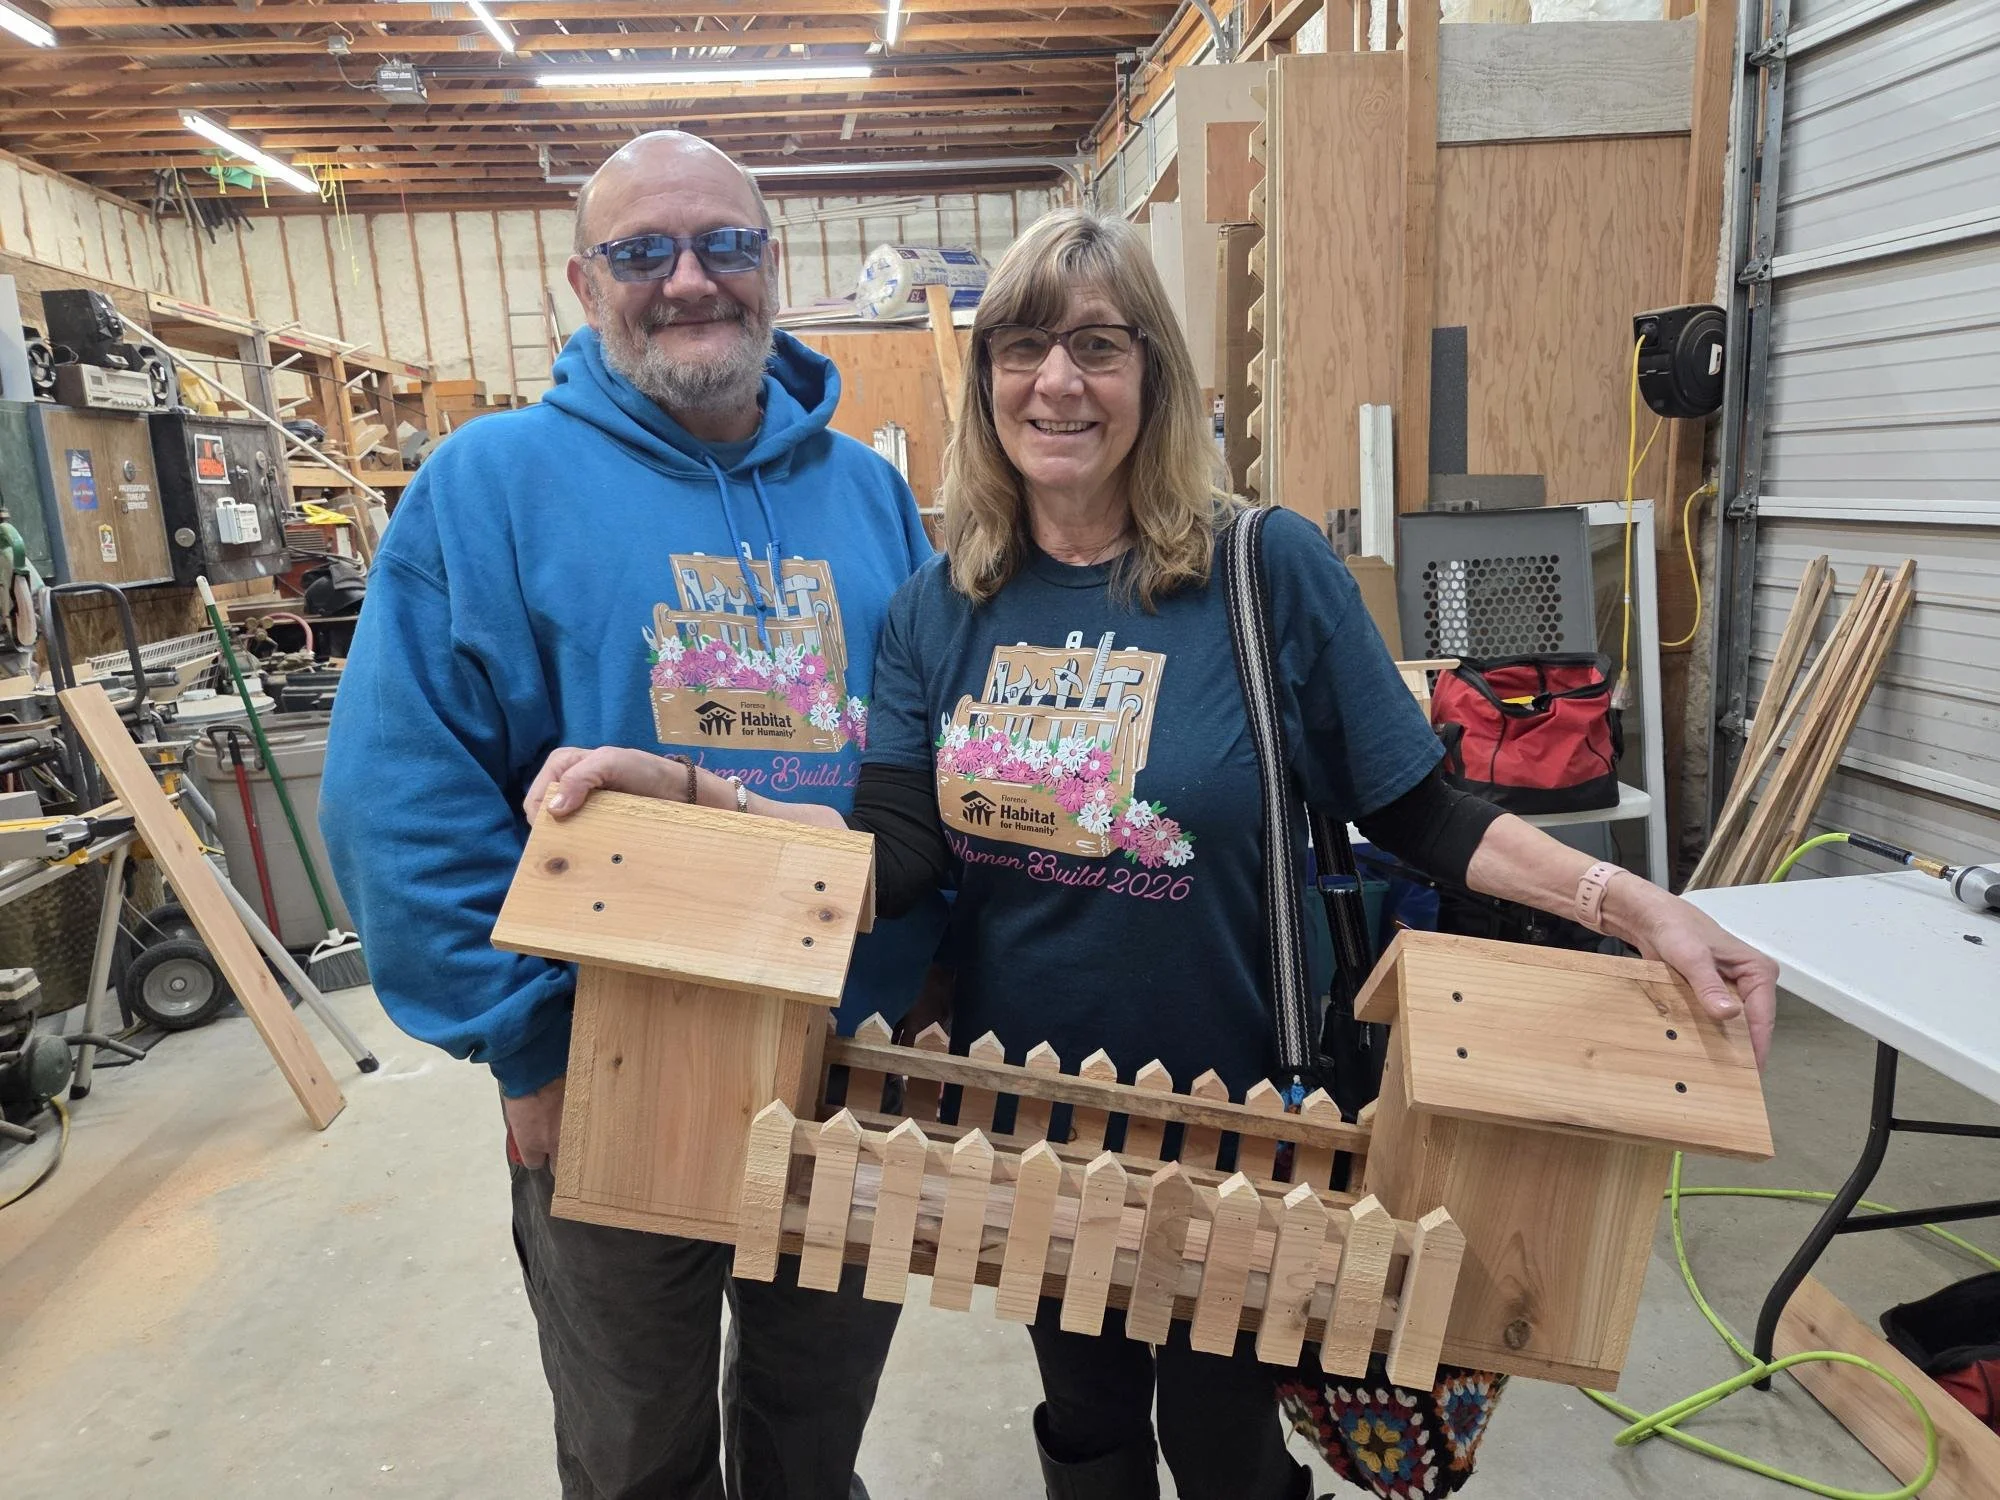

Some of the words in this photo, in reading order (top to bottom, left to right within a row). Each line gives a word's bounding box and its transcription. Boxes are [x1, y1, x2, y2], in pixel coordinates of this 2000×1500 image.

[741, 711, 793, 728] Habitat
[742, 727, 754, 736] for
[757, 727, 793, 739] Humanity
[770, 756, 842, 792] Build
[1001, 794, 1028, 804] Florence
[1000, 804, 1056, 826] Habitat
[1000, 820, 1012, 829] for
[1015, 821, 1055, 837] Humanity
[944, 829, 1025, 870] Women
[1027, 846, 1107, 887] Build
[1107, 868, 1195, 901] 2026
